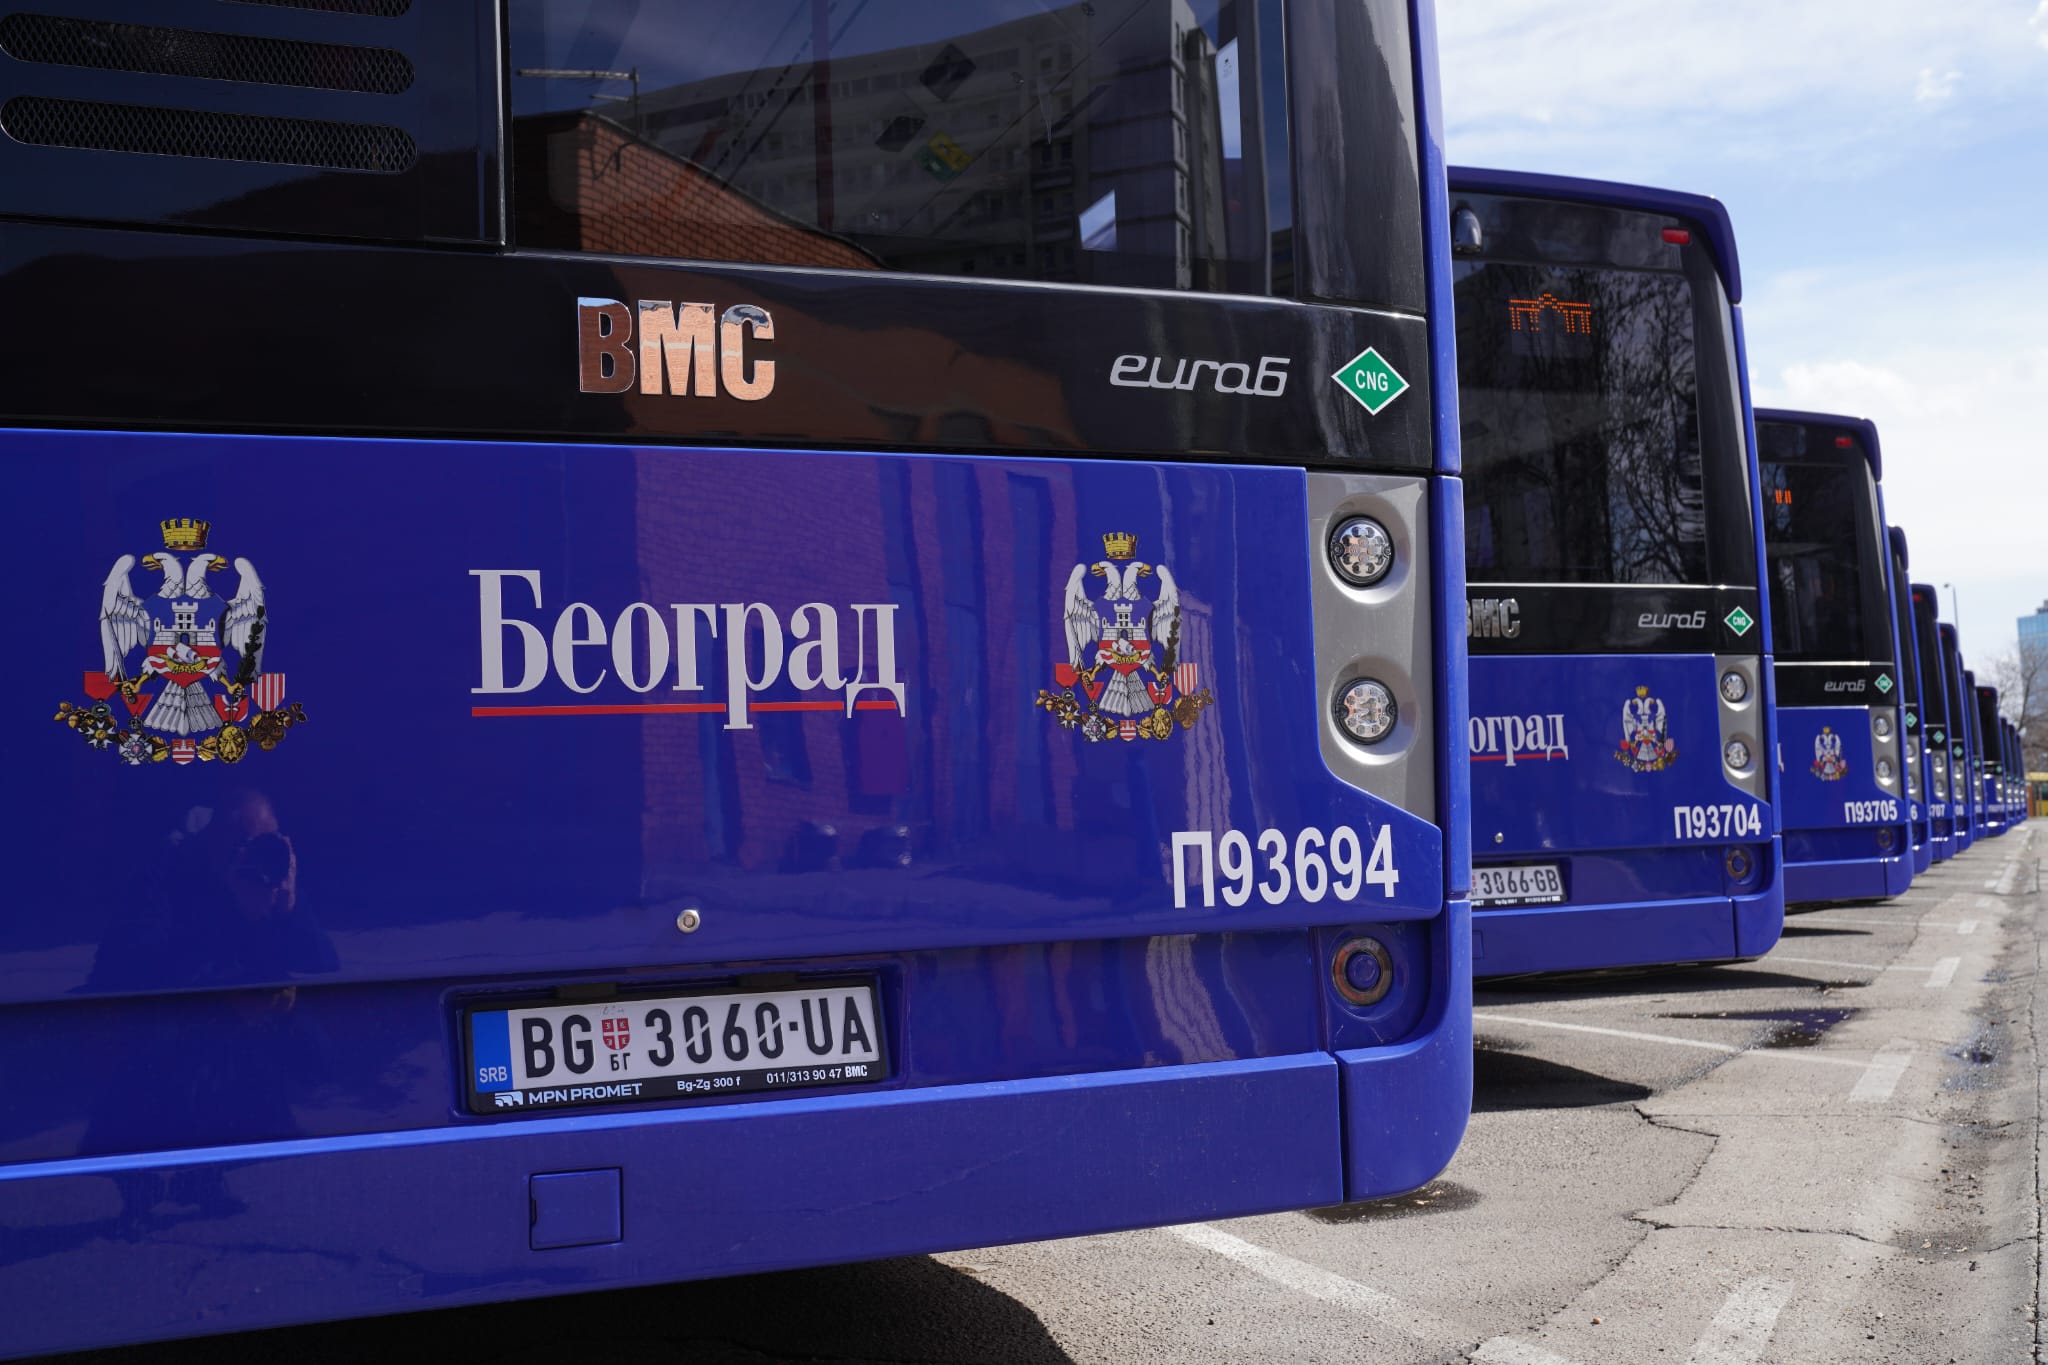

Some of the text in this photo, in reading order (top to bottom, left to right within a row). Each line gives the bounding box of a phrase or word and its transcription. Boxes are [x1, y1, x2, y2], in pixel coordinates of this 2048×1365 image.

[577, 297, 776, 401] BMC
[1355, 369, 1388, 392] CNG
[468, 569, 907, 730] Београд
[1673, 803, 1762, 839] П93704
[1845, 801, 1897, 823] П93705
[1171, 824, 1400, 908] П93694
[479, 1066, 508, 1084] SRB
[677, 1079, 711, 1092] Bg-Zg
[713, 1078, 734, 1088] 300
[766, 1064, 868, 1084] 011/313 90 47 BMC
[529, 1082, 643, 1105] MPN PROMET
